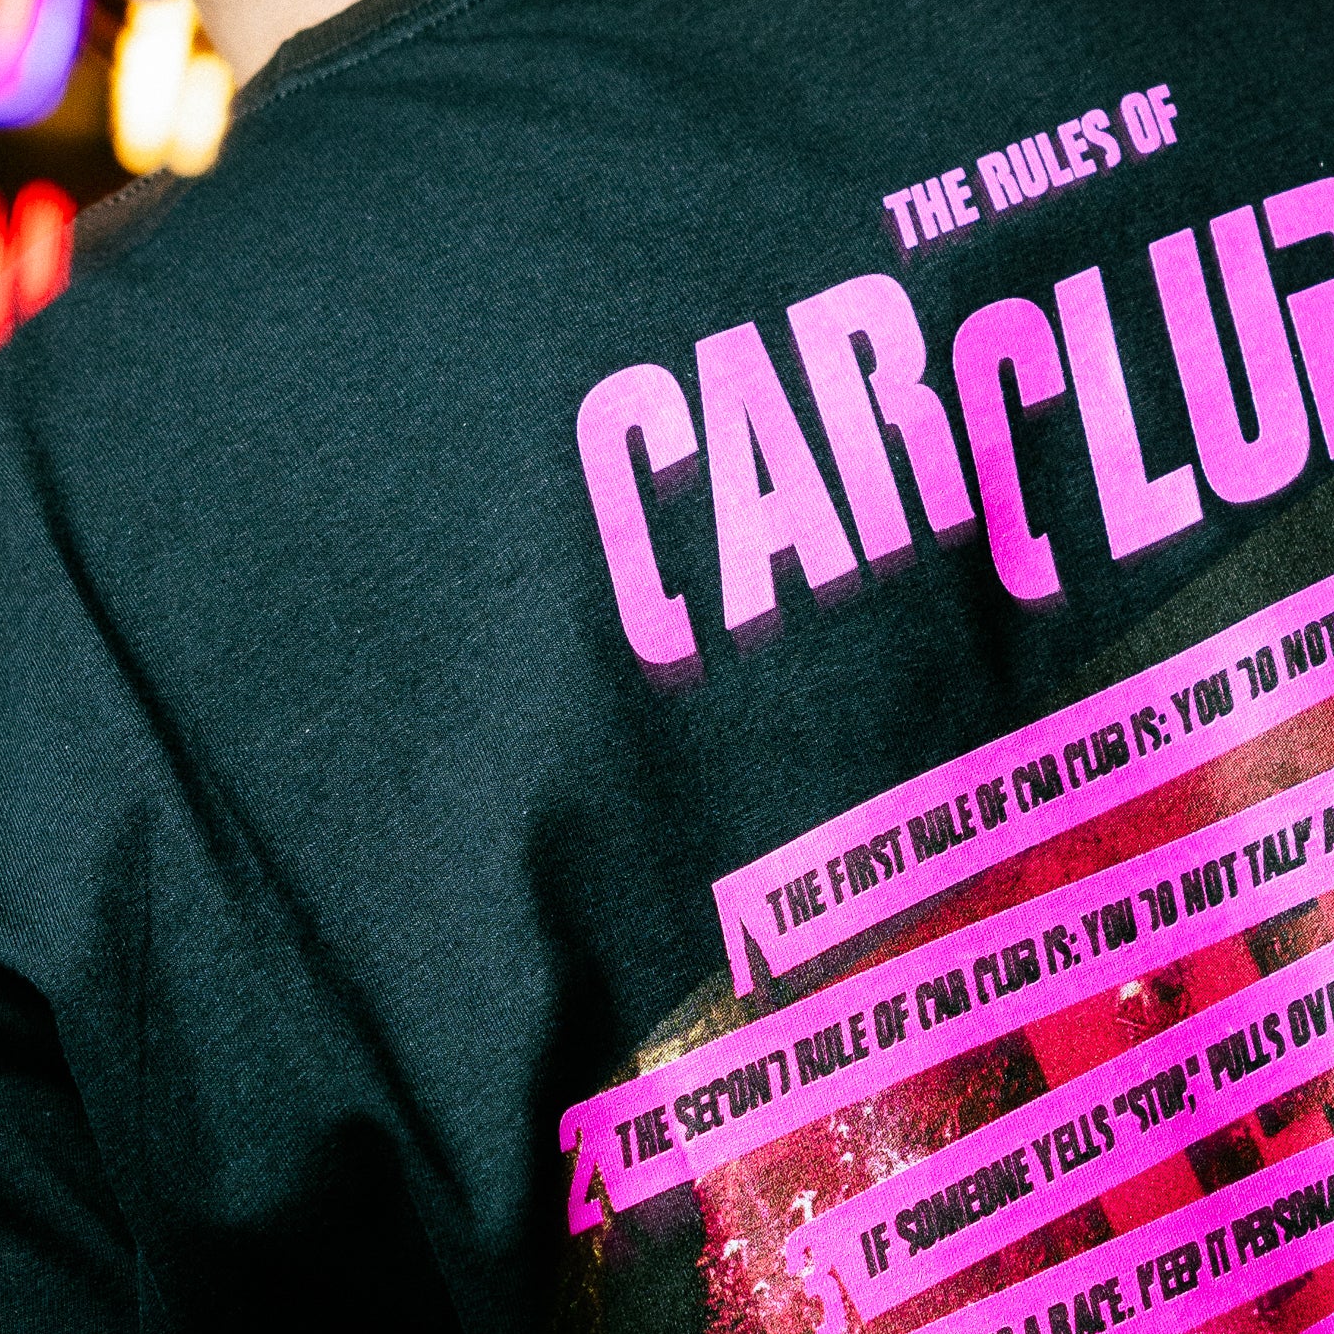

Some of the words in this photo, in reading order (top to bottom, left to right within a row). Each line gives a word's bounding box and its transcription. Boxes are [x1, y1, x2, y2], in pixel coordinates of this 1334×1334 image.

[883, 167, 981, 251] THE
[977, 108, 1122, 212] RULES
[1119, 83, 1179, 152] OF
[766, 876, 826, 937] THE
[827, 827, 906, 904] FIRST
[906, 795, 972, 865] RULE
[975, 776, 1008, 831] OF
[1013, 754, 1065, 813] CAR
[1066, 721, 1131, 789] CLUB
[1133, 706, 1171, 756] IS:
[1171, 669, 1233, 735] YOU
[615, 1107, 673, 1167] THE
[794, 1012, 870, 1086] RULE
[874, 992, 909, 1049] OF
[916, 969, 972, 1030] CAR
[973, 938, 1041, 1005] CLUB
[1046, 925, 1081, 974] IS:
[1081, 896, 1137, 957] YOU
[1180, 850, 1238, 916] NOT
[859, 1222, 891, 1279] IF
[895, 1146, 1034, 1255] SOMEONE
[1030, 1103, 1115, 1186] YELLS
[1204, 1012, 1287, 1091] PULLS
[1205, 1228, 1232, 1280] IT
